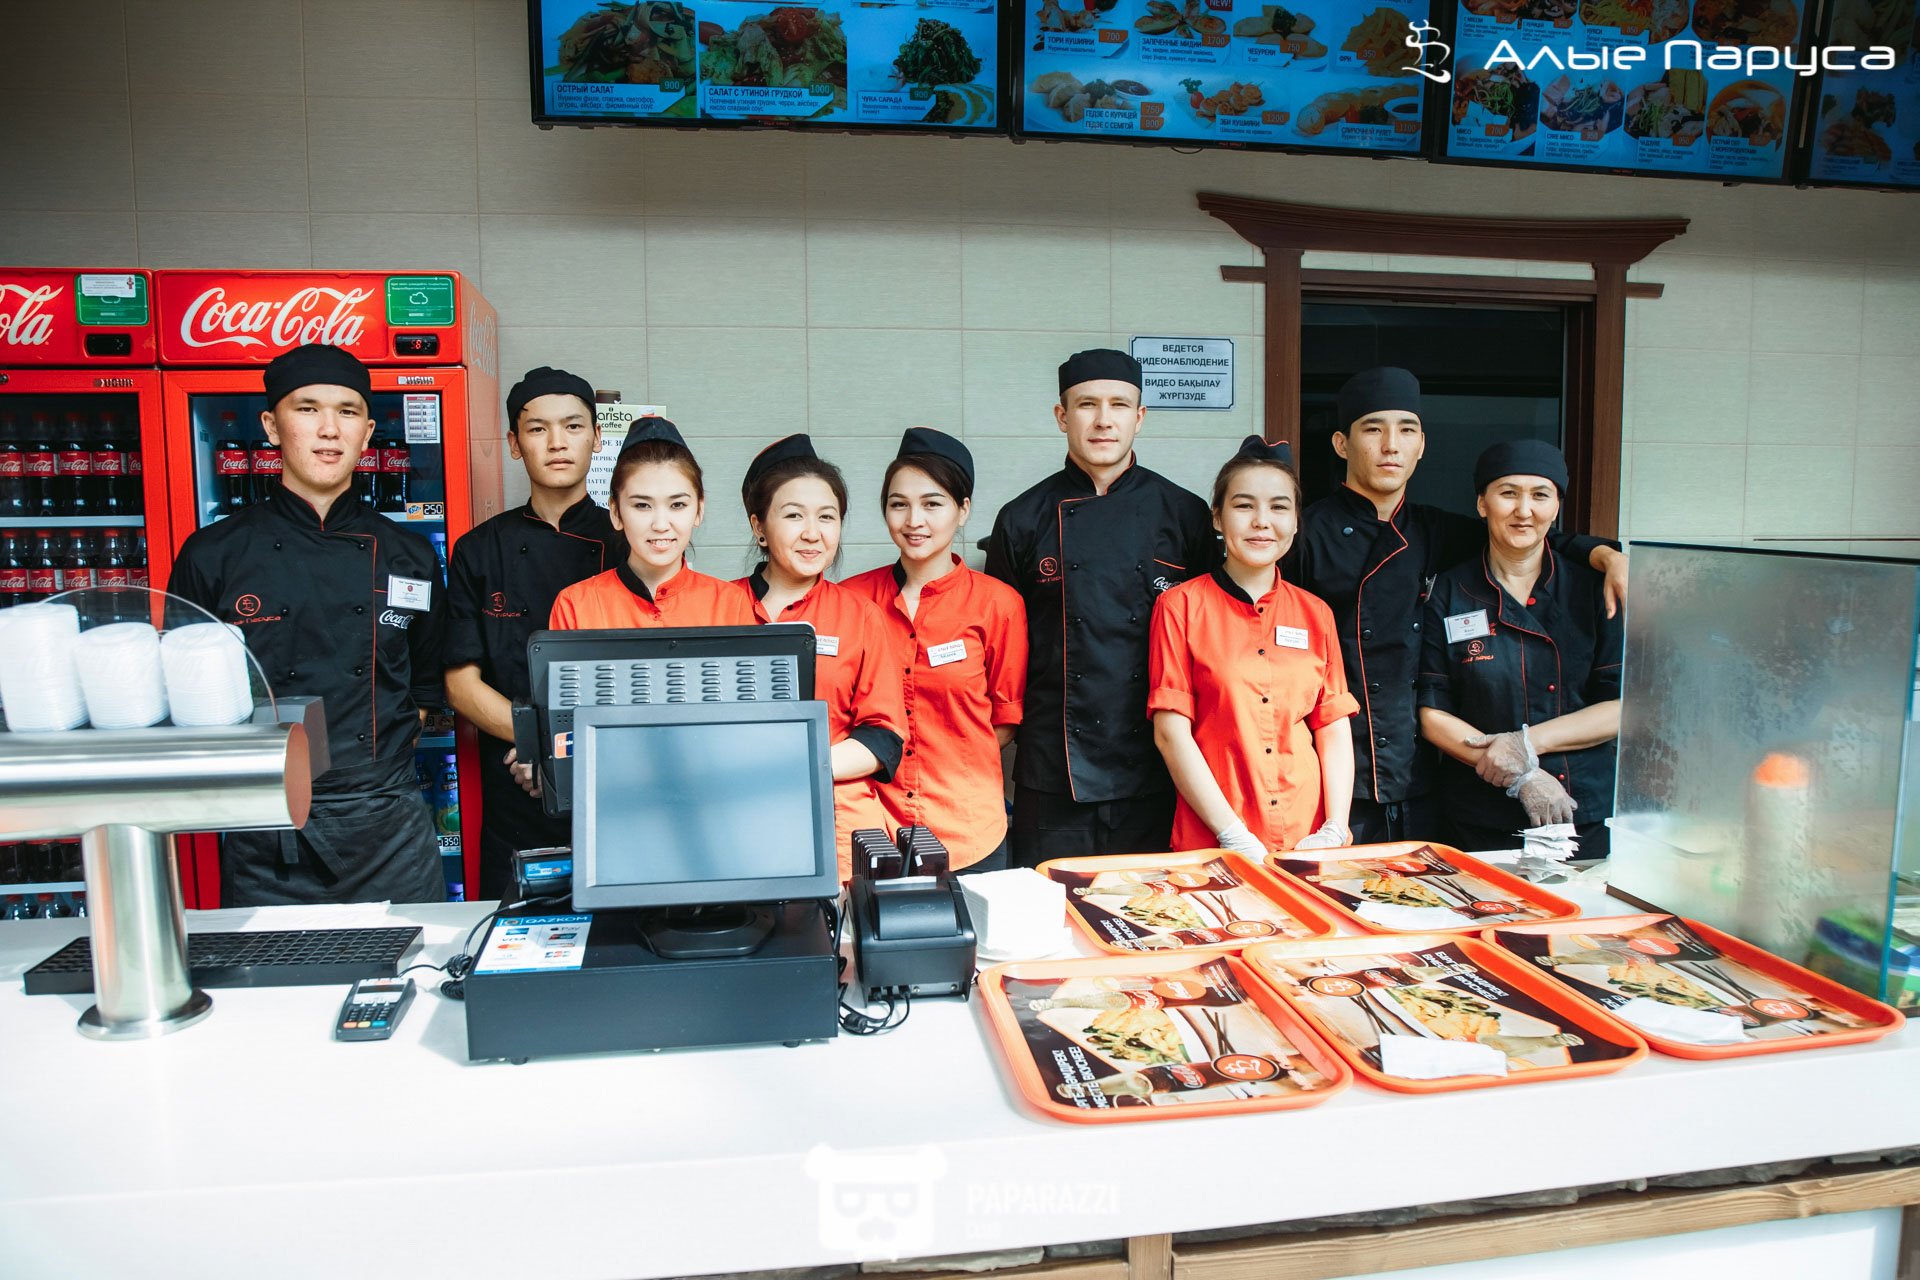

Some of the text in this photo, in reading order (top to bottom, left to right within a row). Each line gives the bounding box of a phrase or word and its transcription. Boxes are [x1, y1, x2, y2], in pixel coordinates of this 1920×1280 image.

[1048, 36, 1063, 44] ТОРИ
[1106, 31, 1120, 41] 700
[1207, 36, 1225, 46] 1700
[557, 84, 614, 94] ОСТРЫЙ САЛАТ
[665, 81, 679, 90] 900
[811, 84, 830, 94] 1000
[709, 88, 803, 99] САЛАТ С УТИНОЙ ГРУДКОЙ
[862, 95, 902, 105] ЧУКА САРАДА
[1110, 110, 1137, 120] КУРИЦЕЙ
[0, 284, 64, 346] ola
[180, 287, 376, 348] Coca-Cola
[1163, 344, 1204, 354] ВЕДЕТСЯ
[1137, 357, 1230, 367] ВИДЕОНАБЛЮДЕНИЕ
[1145, 379, 1221, 389] ВИДЕО БАҚЫЛАУ
[1159, 392, 1207, 402] ЖҮРГІЗУДЕ
[595, 411, 633, 422] arista
[601, 421, 623, 429] coffee
[424, 504, 443, 515] 250
[443, 836, 459, 847] 350
[525, 916, 588, 924] QAZKOM
[1087, 1082, 1110, 1108] МЕСТЕ
